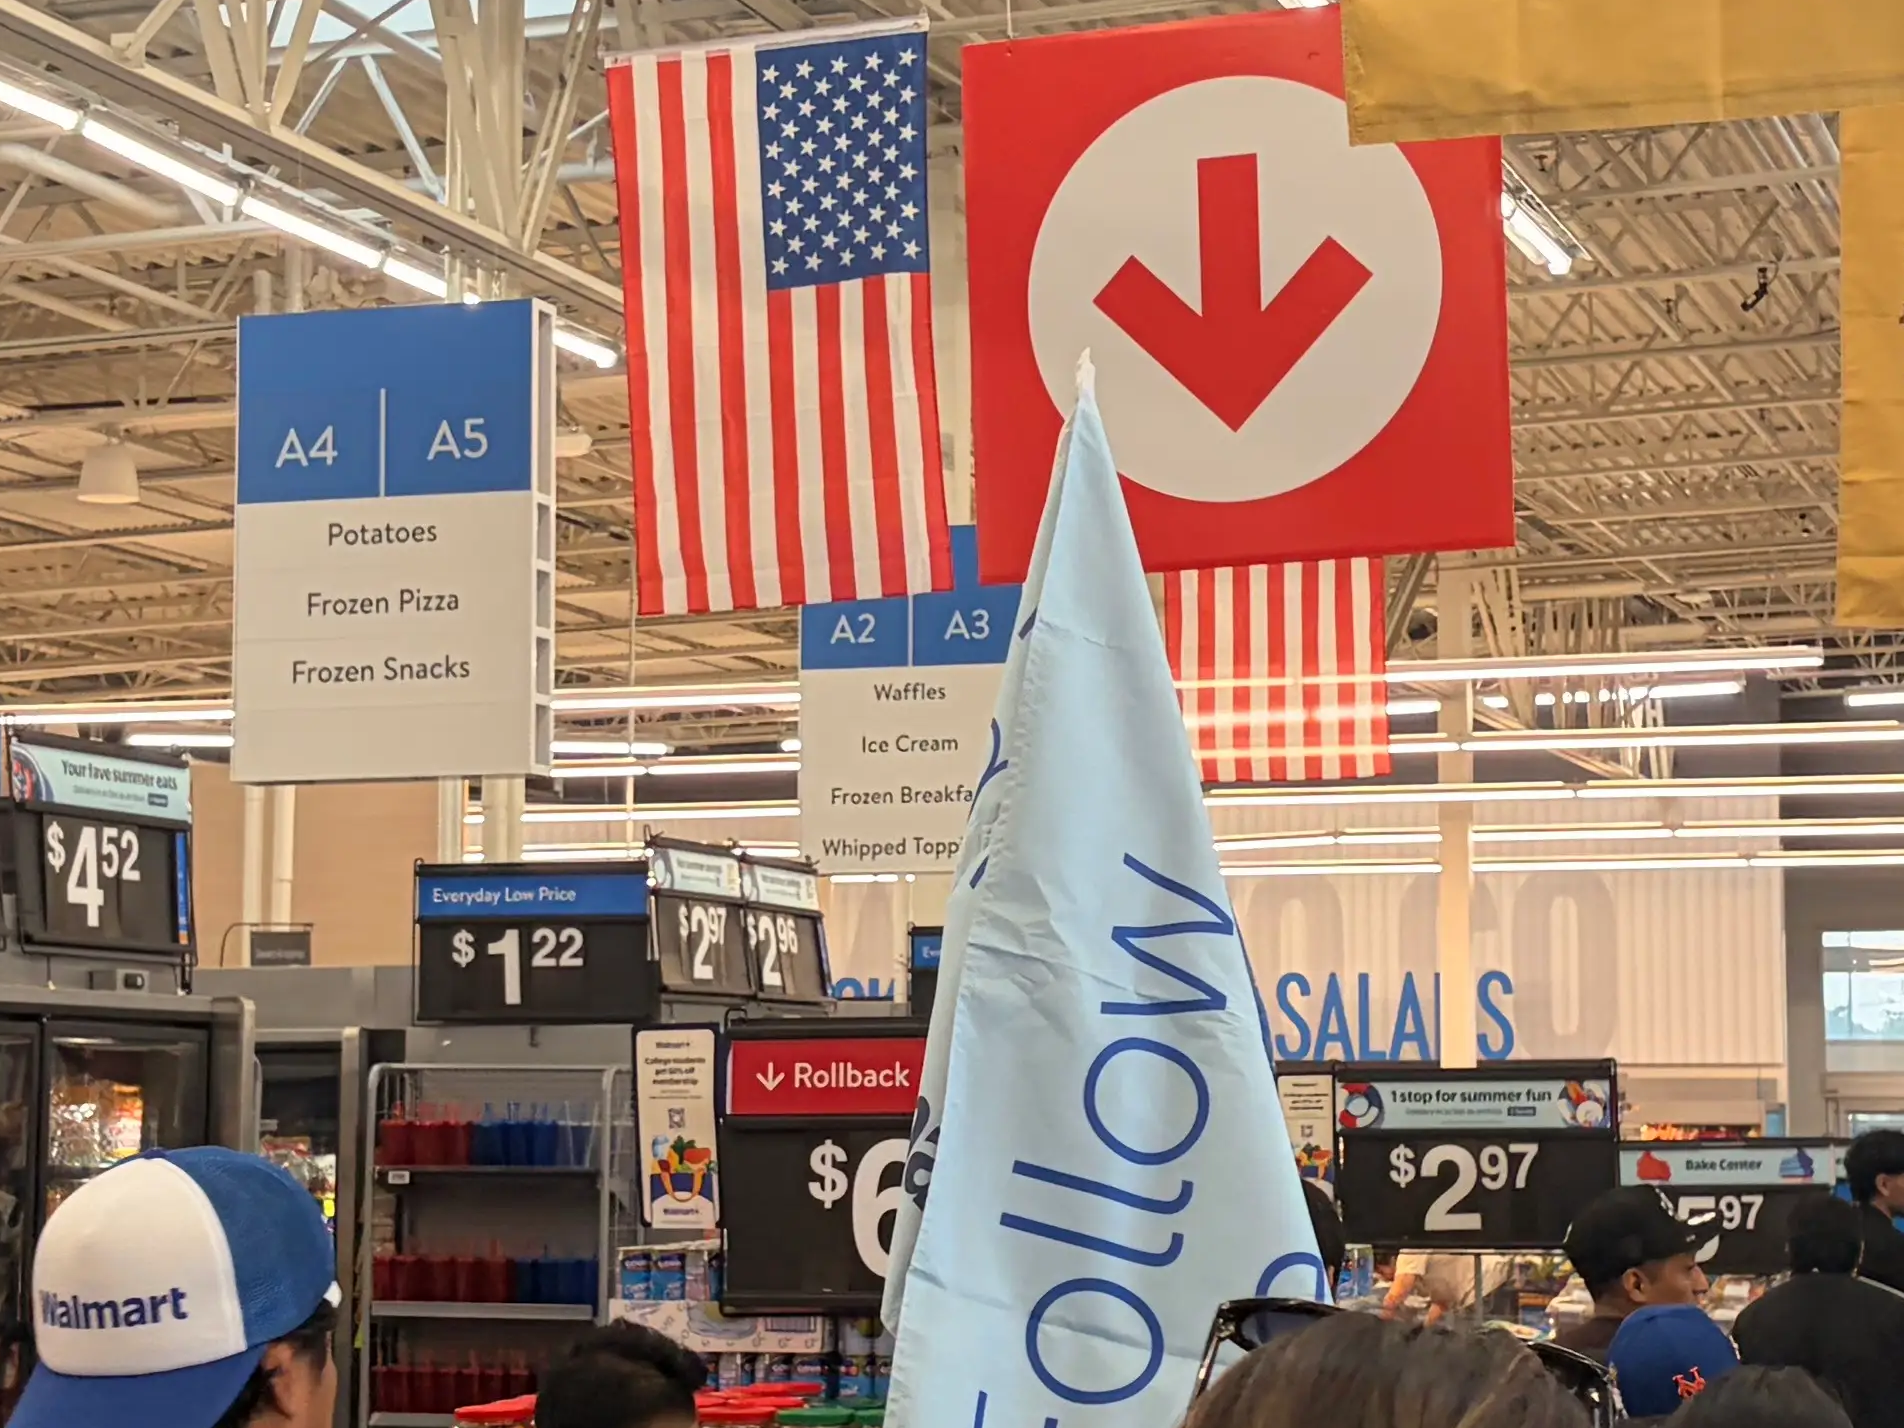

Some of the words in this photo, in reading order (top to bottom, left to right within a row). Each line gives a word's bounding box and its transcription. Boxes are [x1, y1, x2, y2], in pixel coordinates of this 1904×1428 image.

[275, 425, 338, 468] A4
[426, 418, 489, 461] A5
[328, 519, 437, 547] Potatoes
[308, 591, 389, 617] Frozen
[399, 588, 460, 613] Pizza
[830, 614, 876, 644] A2
[944, 609, 990, 641] A3
[292, 659, 374, 684] Frozen
[384, 655, 470, 682] Snacks
[874, 682, 946, 701] Waffles
[862, 735, 889, 753] Ice
[896, 734, 959, 753] Cream
[61, 758, 87, 776] Your
[112, 769, 153, 787] summer
[156, 772, 178, 791] eats
[831, 787, 893, 806] Frozen
[823, 838, 906, 861] Whipped
[433, 887, 501, 906] Everyday
[504, 887, 530, 902] Low
[533, 886, 577, 902] Price
[1276, 970, 1515, 1062] SALAS
[794, 1061, 911, 1090] Rollback
[1400, 1089, 1434, 1105] stop
[1436, 1088, 1457, 1102] for
[1459, 1089, 1523, 1103] summer
[1526, 1088, 1552, 1102] fun
[1684, 1157, 1717, 1171] Bake
[1719, 1158, 1763, 1172] Center
[40, 1286, 189, 1332] Walmart
